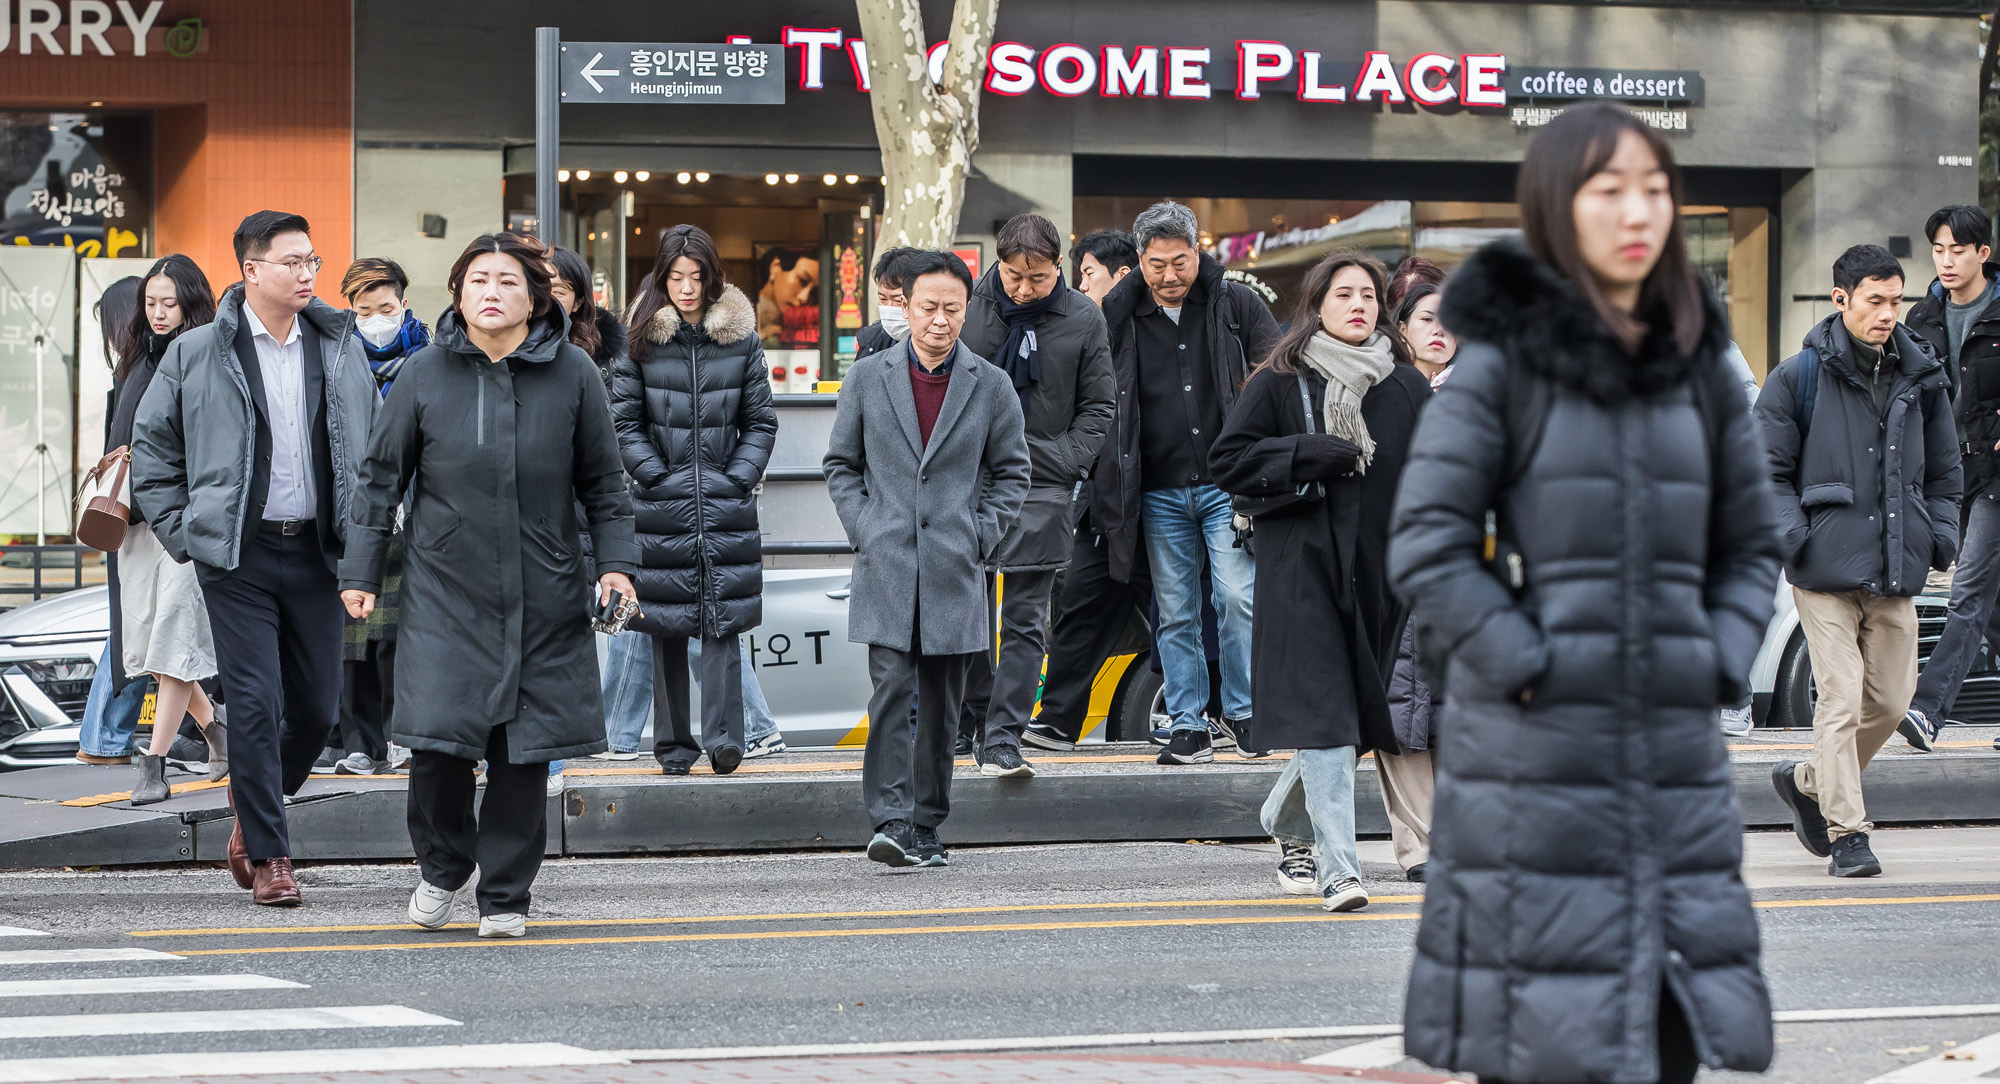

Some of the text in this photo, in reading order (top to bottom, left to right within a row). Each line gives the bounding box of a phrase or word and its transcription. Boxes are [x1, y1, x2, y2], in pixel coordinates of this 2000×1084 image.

[0, 0, 164, 57] RRY
[629, 49, 768, 77] 흥인지문 방향
[783, 27, 1507, 107] TSOME PLACE
[630, 81, 723, 98] Heunginjimun
[1521, 70, 1686, 98] coffee & dessert
[1245, 273, 1279, 304] PLACE
[804, 630, 830, 665] T
